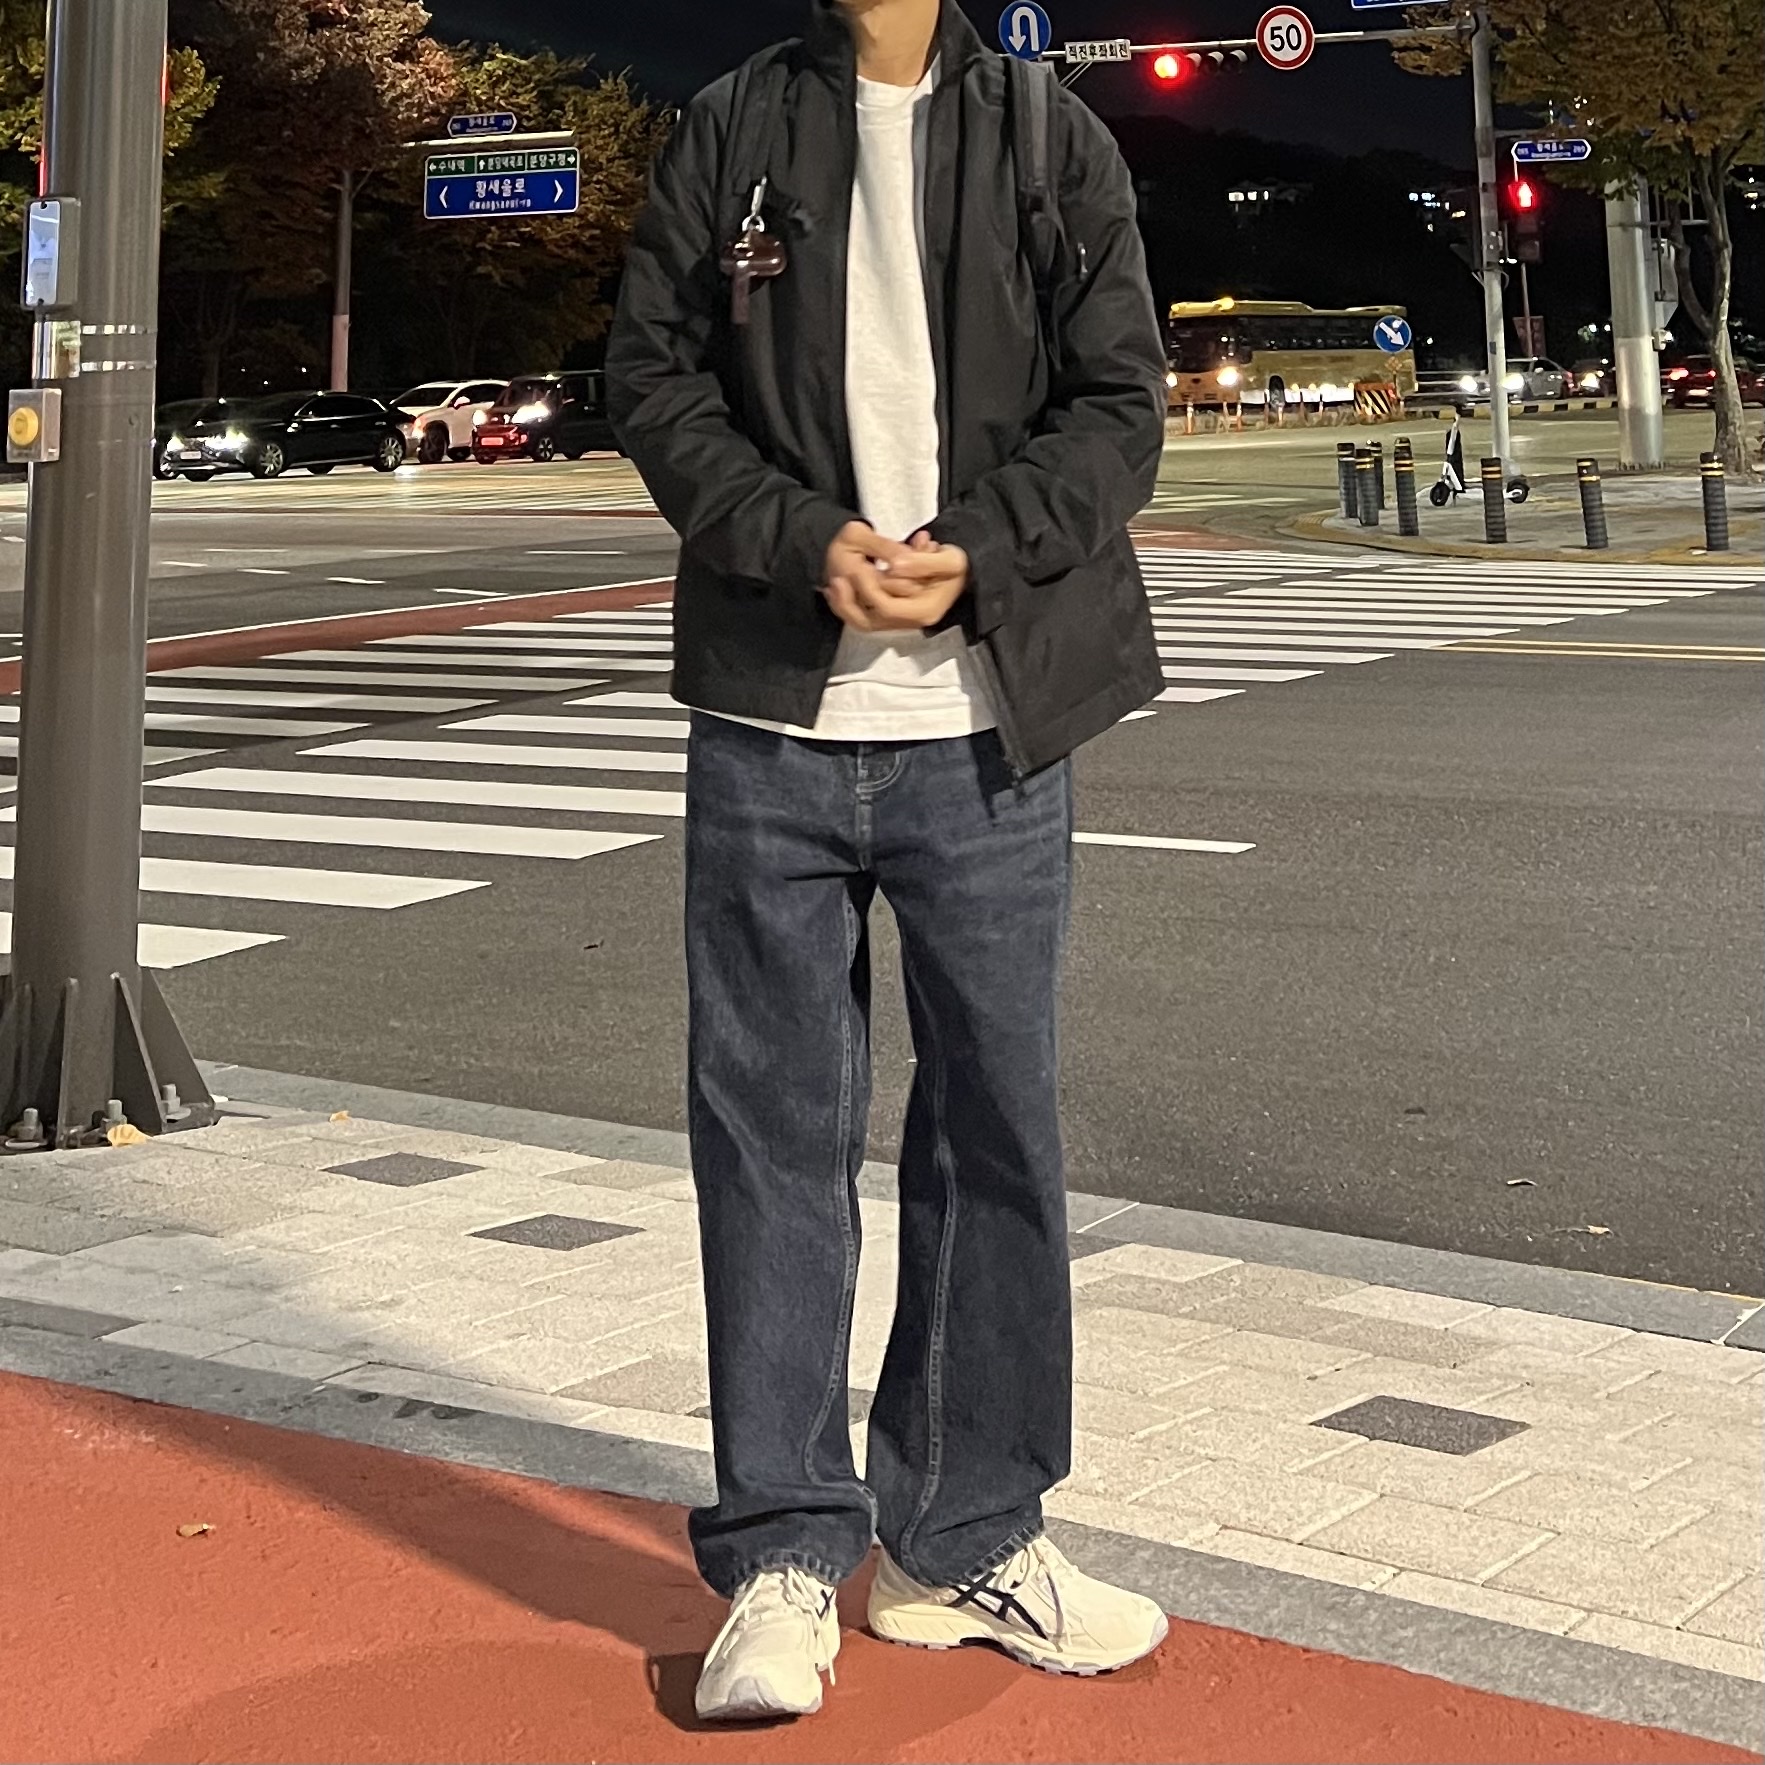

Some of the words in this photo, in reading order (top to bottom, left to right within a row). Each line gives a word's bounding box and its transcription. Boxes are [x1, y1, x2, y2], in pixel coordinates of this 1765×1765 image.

[1270, 24, 1302, 51] 50
[439, 160, 465, 172] 수내역
[476, 178, 525, 198] 황새울로
